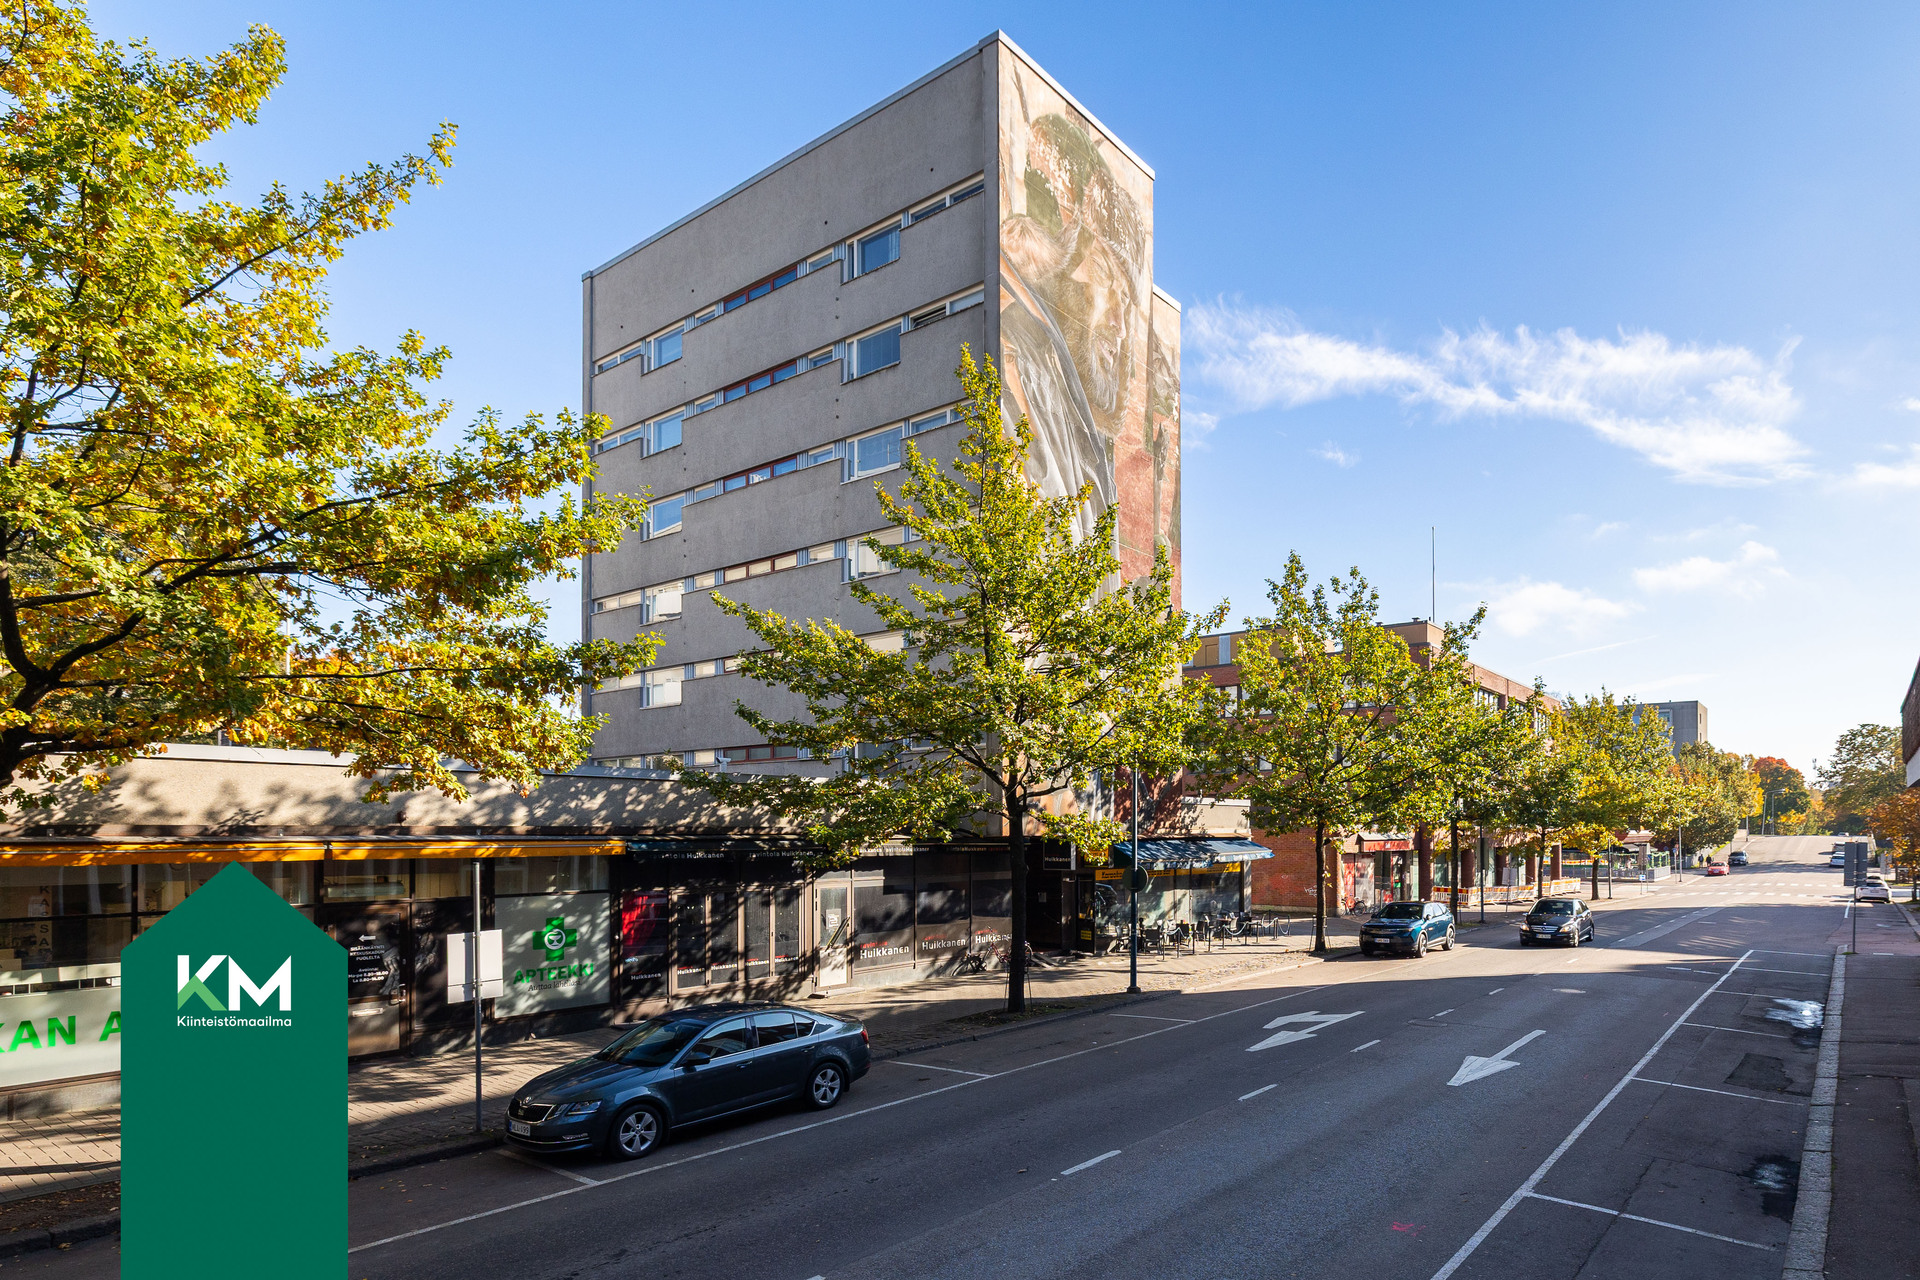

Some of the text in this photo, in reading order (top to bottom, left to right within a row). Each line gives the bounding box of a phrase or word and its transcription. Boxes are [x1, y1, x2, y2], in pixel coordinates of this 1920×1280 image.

[922, 939, 966, 951] Huikkanen
[975, 934, 1012, 944] Huikkane
[860, 946, 910, 960] Huikkanen
[513, 963, 594, 985] APTEEKKI
